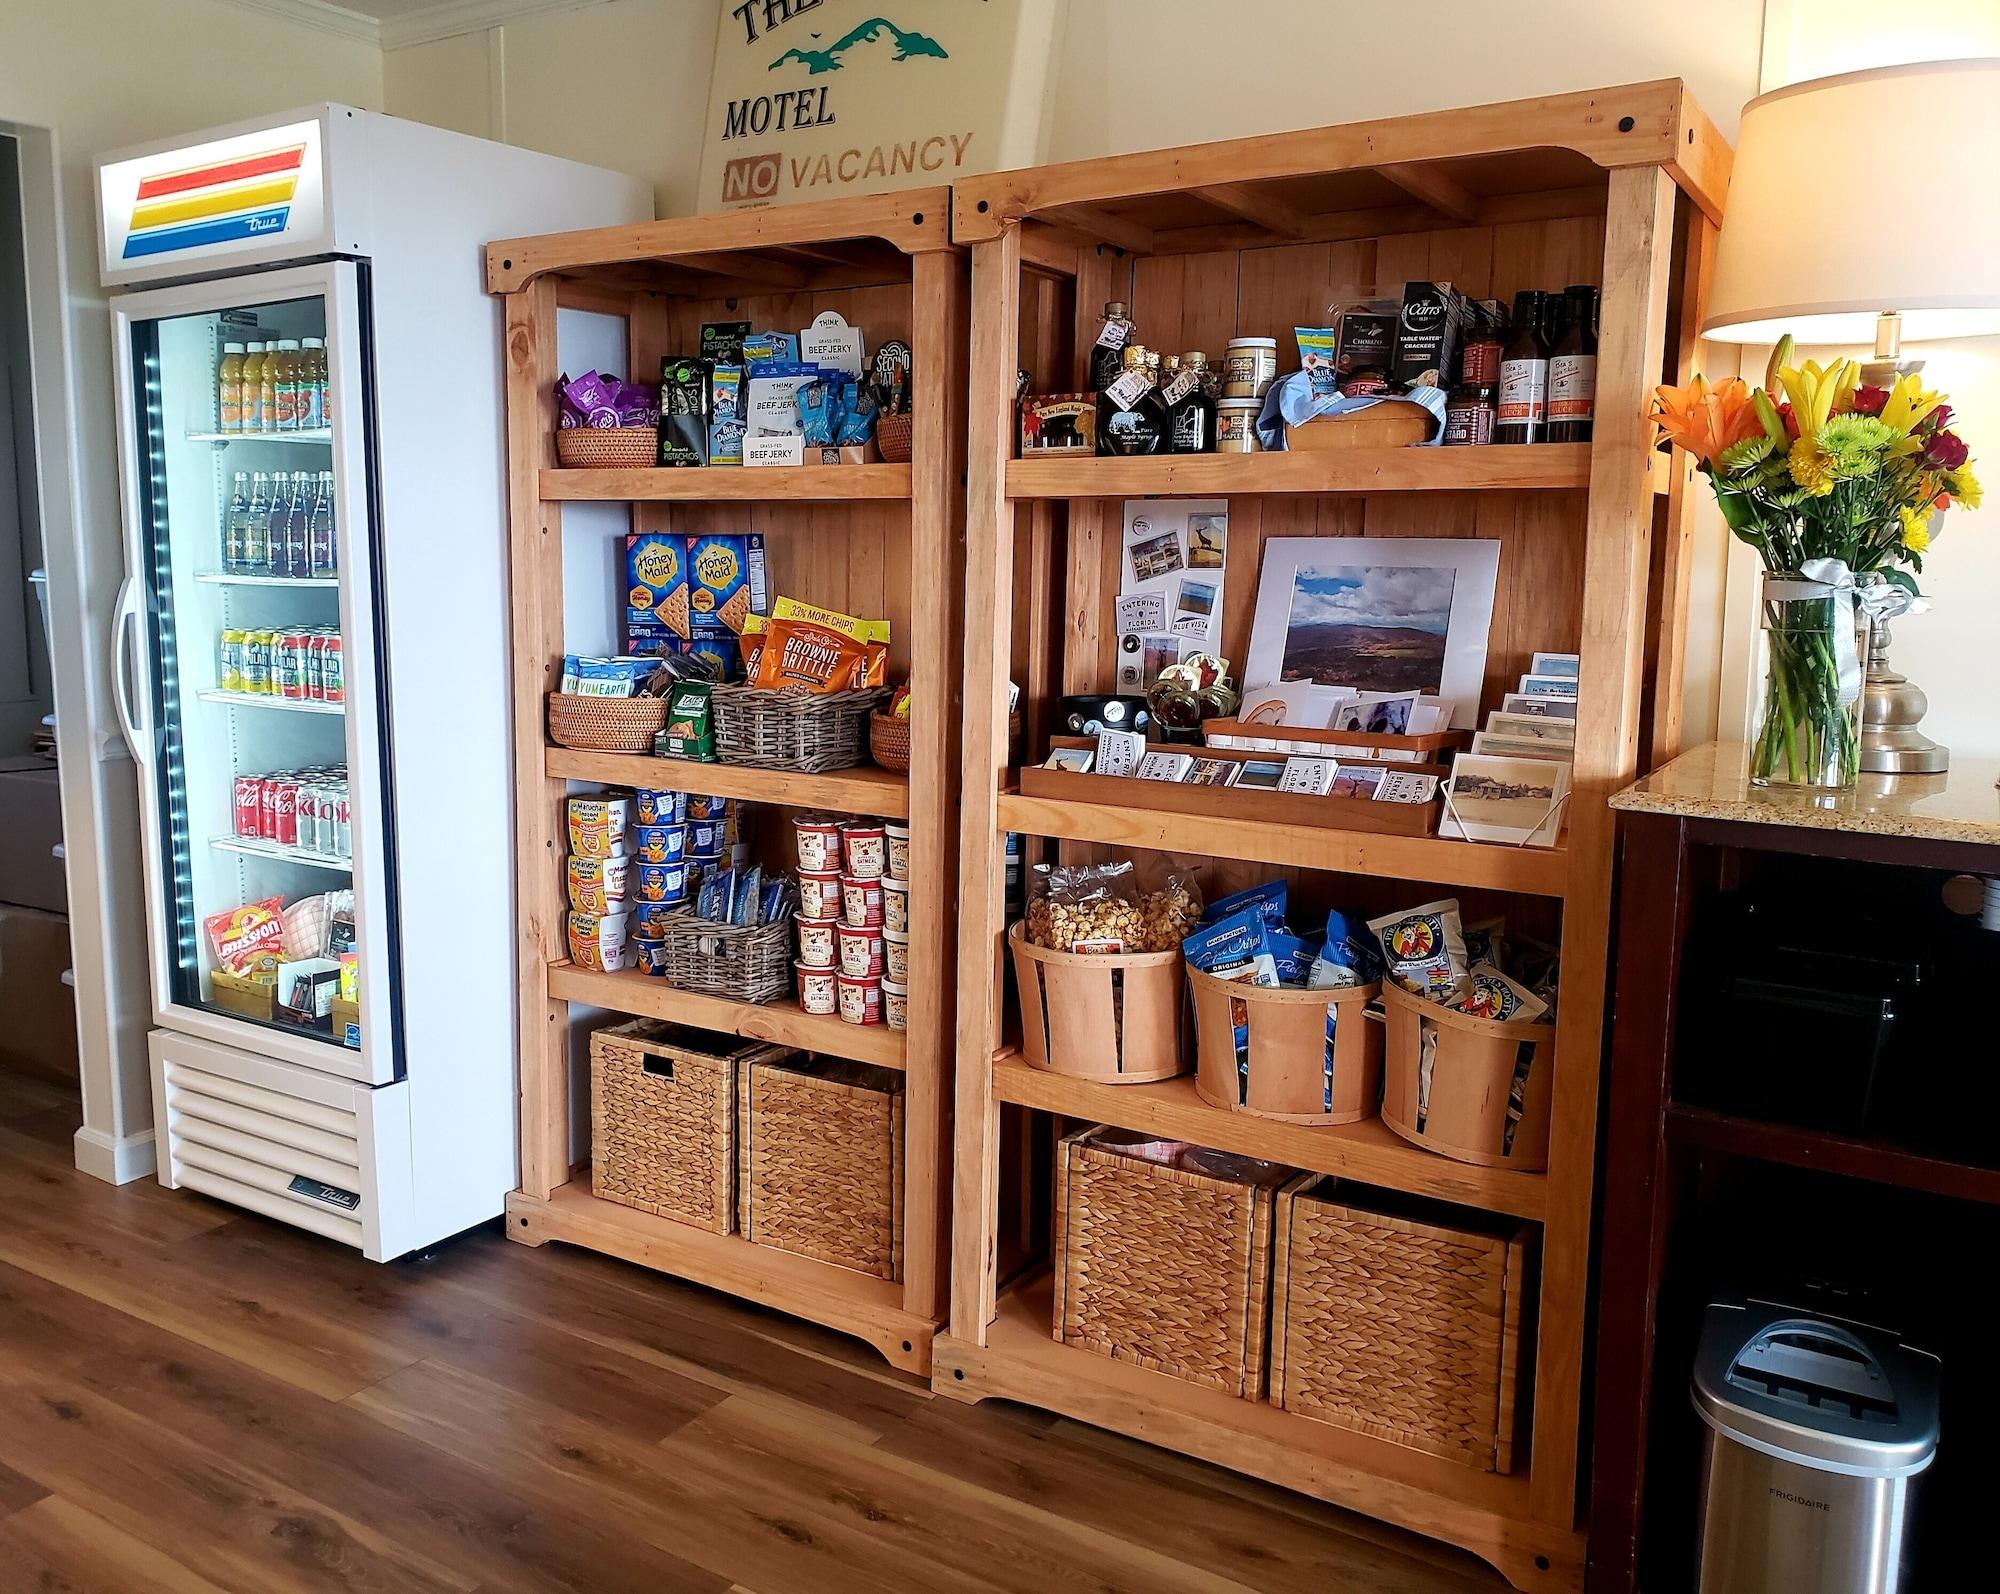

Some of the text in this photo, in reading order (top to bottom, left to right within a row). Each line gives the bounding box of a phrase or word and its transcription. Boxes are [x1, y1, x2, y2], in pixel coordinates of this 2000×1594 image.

[732, 0, 824, 45] TH
[721, 86, 836, 140] MOTEL
[725, 132, 975, 197] NO VACANCY
[818, 319, 839, 328] THINK
[808, 344, 852, 354] BEEF JERKY
[1308, 373, 1336, 384] DIAMON
[772, 382, 794, 390] THINK
[757, 401, 777, 410] BEEF
[664, 452, 699, 460] PISTACHIOS
[750, 449, 793, 459] BEEF JERKY
[638, 552, 673, 570] Honey
[699, 554, 733, 572] Honey
[644, 565, 670, 579] Maid
[705, 567, 731, 581] Maid
[1121, 600, 1160, 612] ENTERING
[790, 604, 855, 633] 33% MORE CHIPS
[1128, 619, 1156, 628] FLORIDA
[1173, 621, 1208, 630] BLUE VISTA
[785, 636, 842, 665] BROWNIE
[245, 652, 269, 667] POLAR
[781, 650, 837, 679] BRITTLE
[1121, 739, 1131, 776] ENTERI
[1287, 768, 1300, 793] FLORI
[577, 802, 606, 812] Maruchan
[576, 861, 601, 870] Maruchan
[1212, 959, 1246, 972] ORIGINAL
[1500, 986, 1512, 1016] BOOTY
[1769, 1488, 1831, 1512] FRIGIDAIRE
